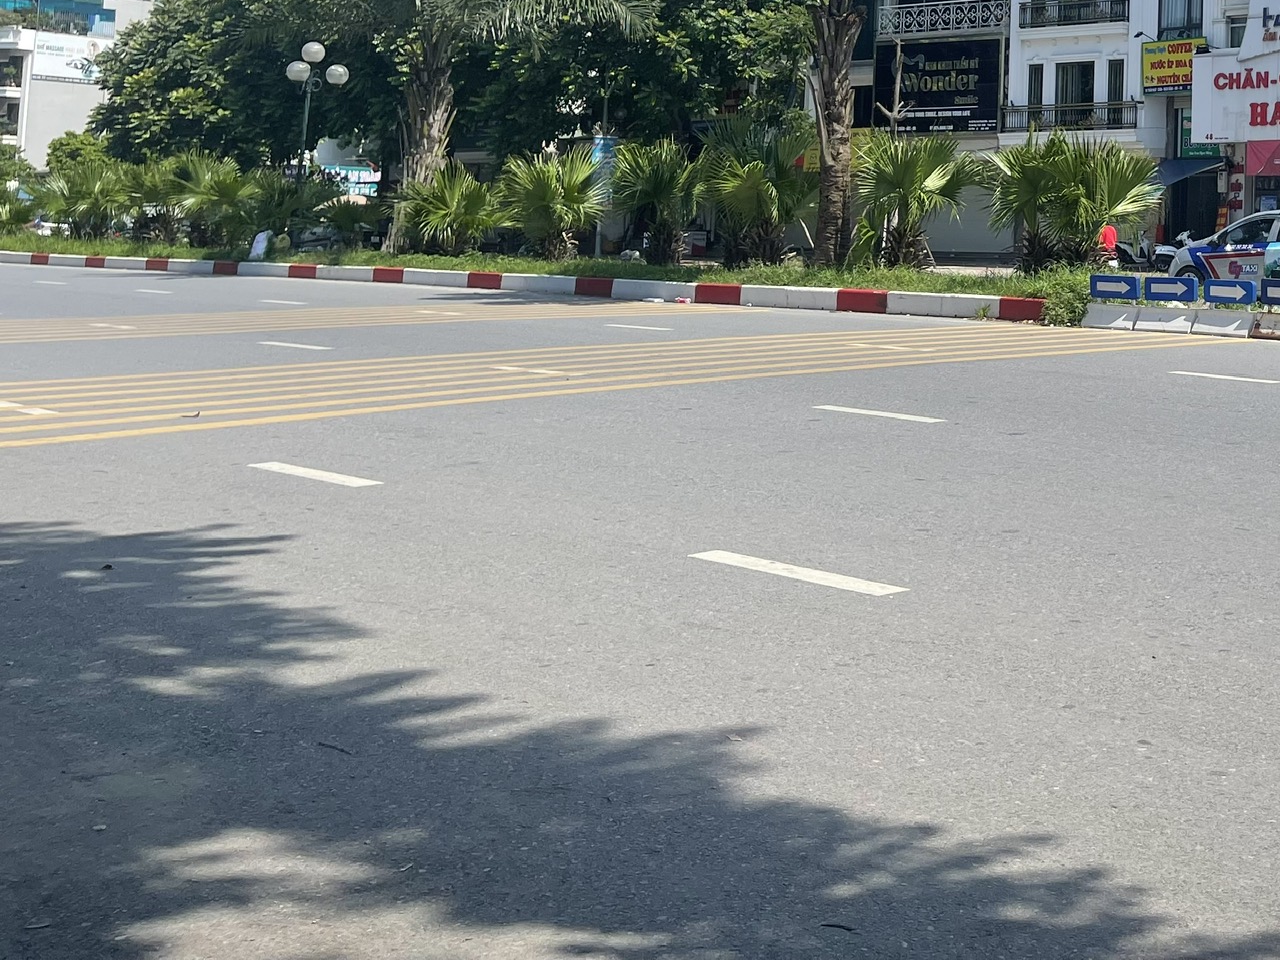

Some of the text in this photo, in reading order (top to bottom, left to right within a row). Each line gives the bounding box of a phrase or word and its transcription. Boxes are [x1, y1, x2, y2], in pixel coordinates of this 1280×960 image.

[1168, 43, 1192, 54] COFFEE
[901, 70, 979, 92] Wonder
[1214, 68, 1269, 90] CHĂN
